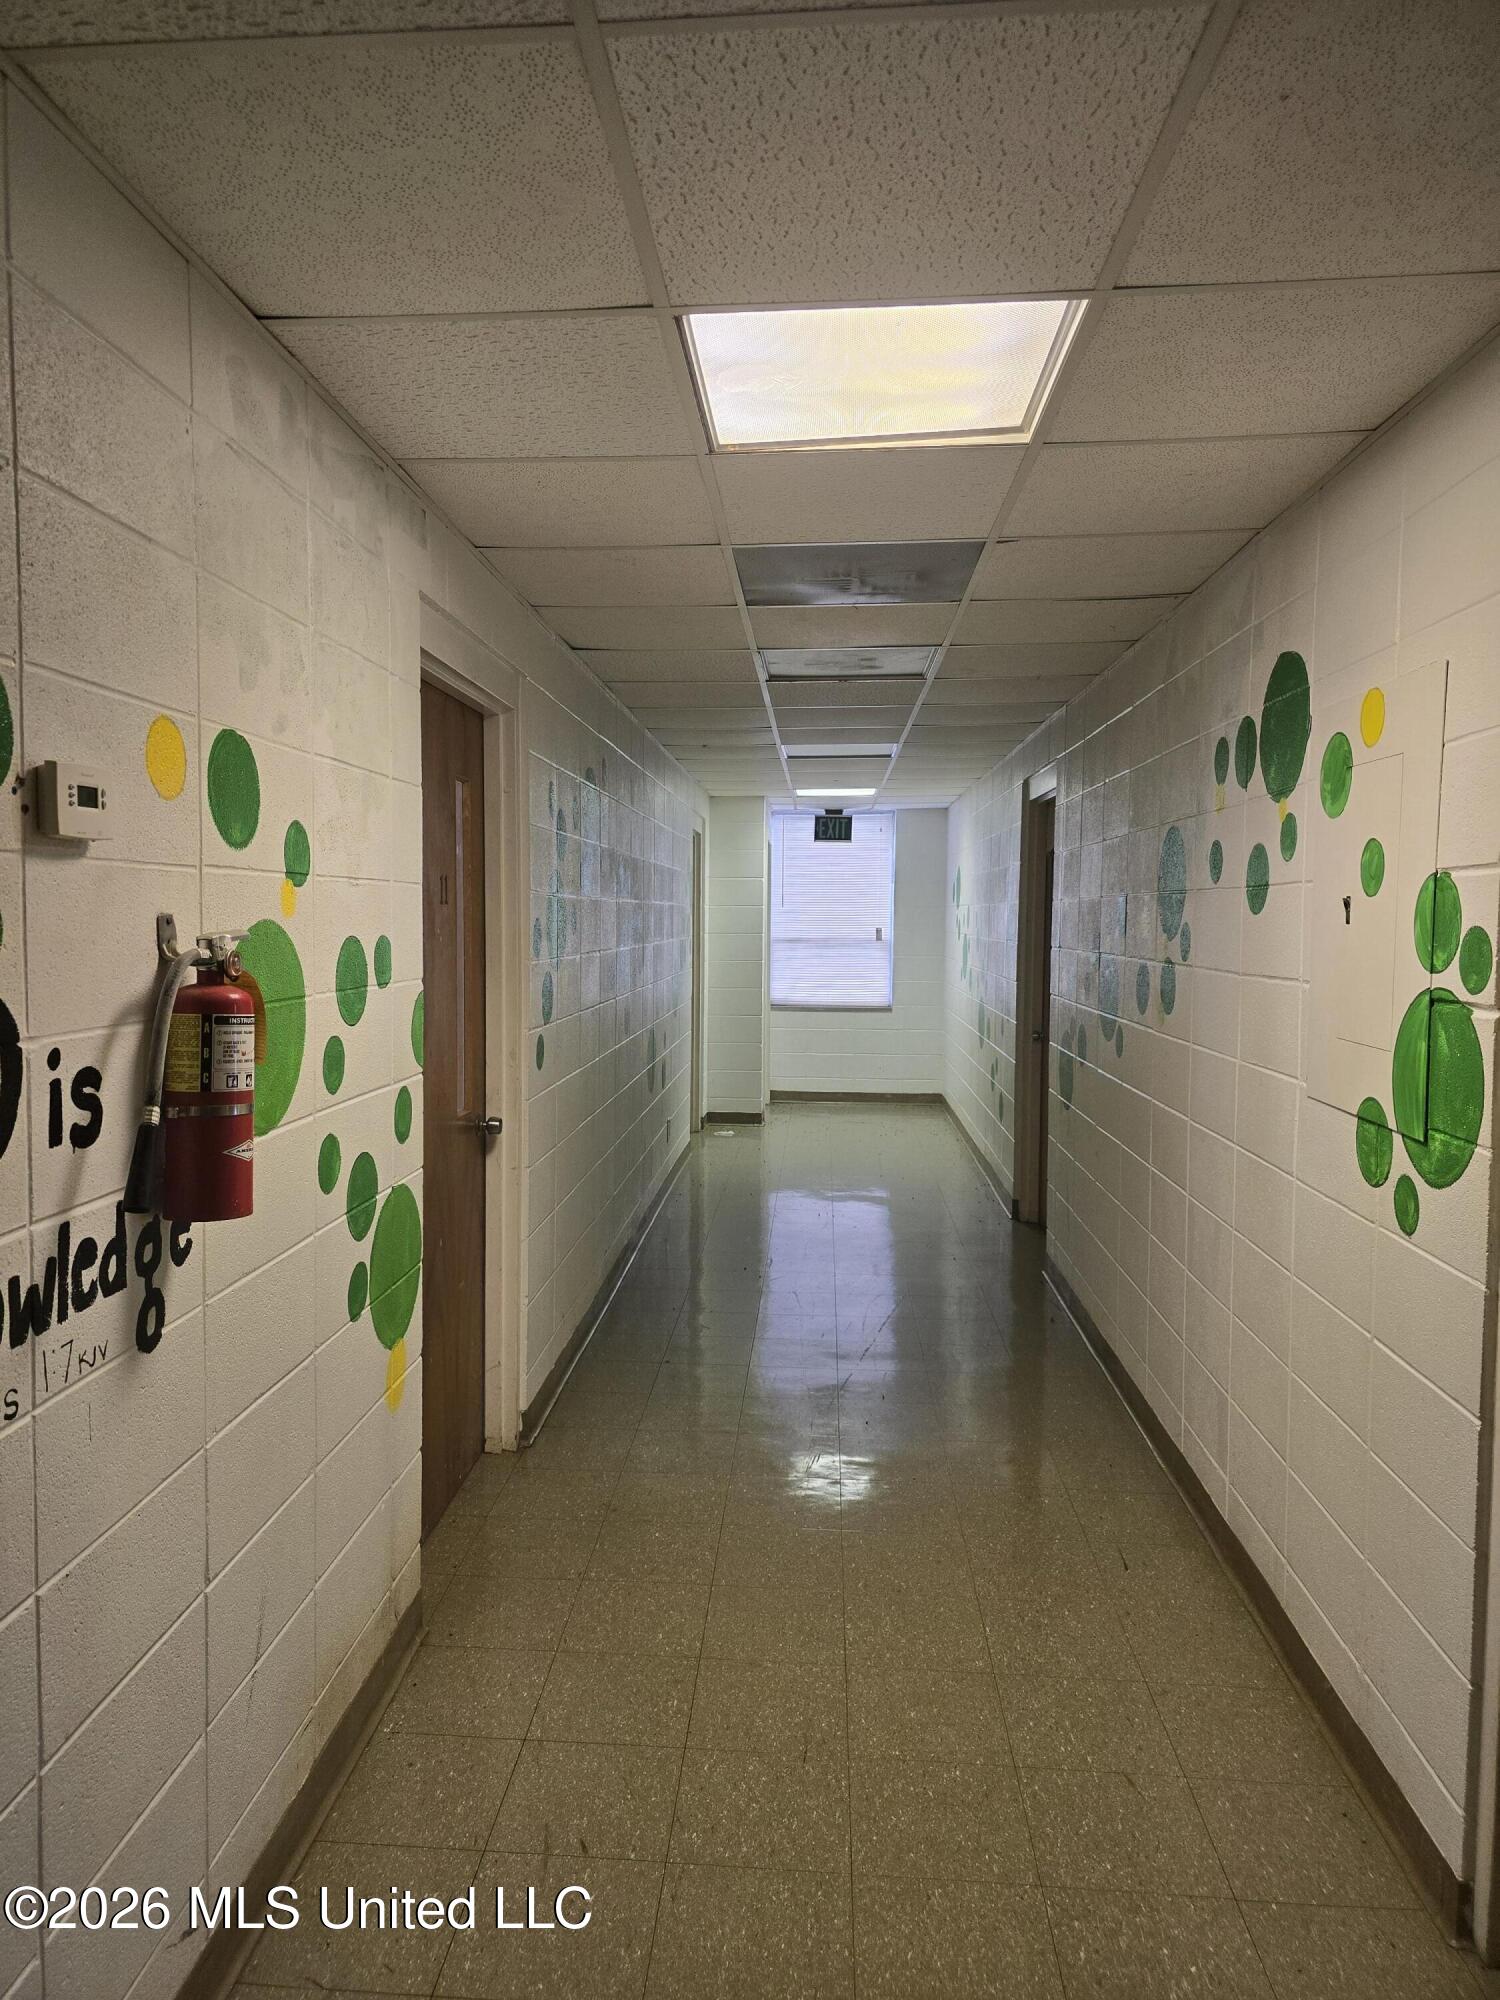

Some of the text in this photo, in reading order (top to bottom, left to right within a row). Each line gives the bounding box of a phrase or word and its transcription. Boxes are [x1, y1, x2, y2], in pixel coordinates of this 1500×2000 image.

[818, 817, 849, 840] EXIT
[46, 1046, 104, 1154] is
[0, 1200, 193, 1354] wledge
[42, 1339, 74, 1393] 1:7
[78, 1339, 109, 1375] KJV
